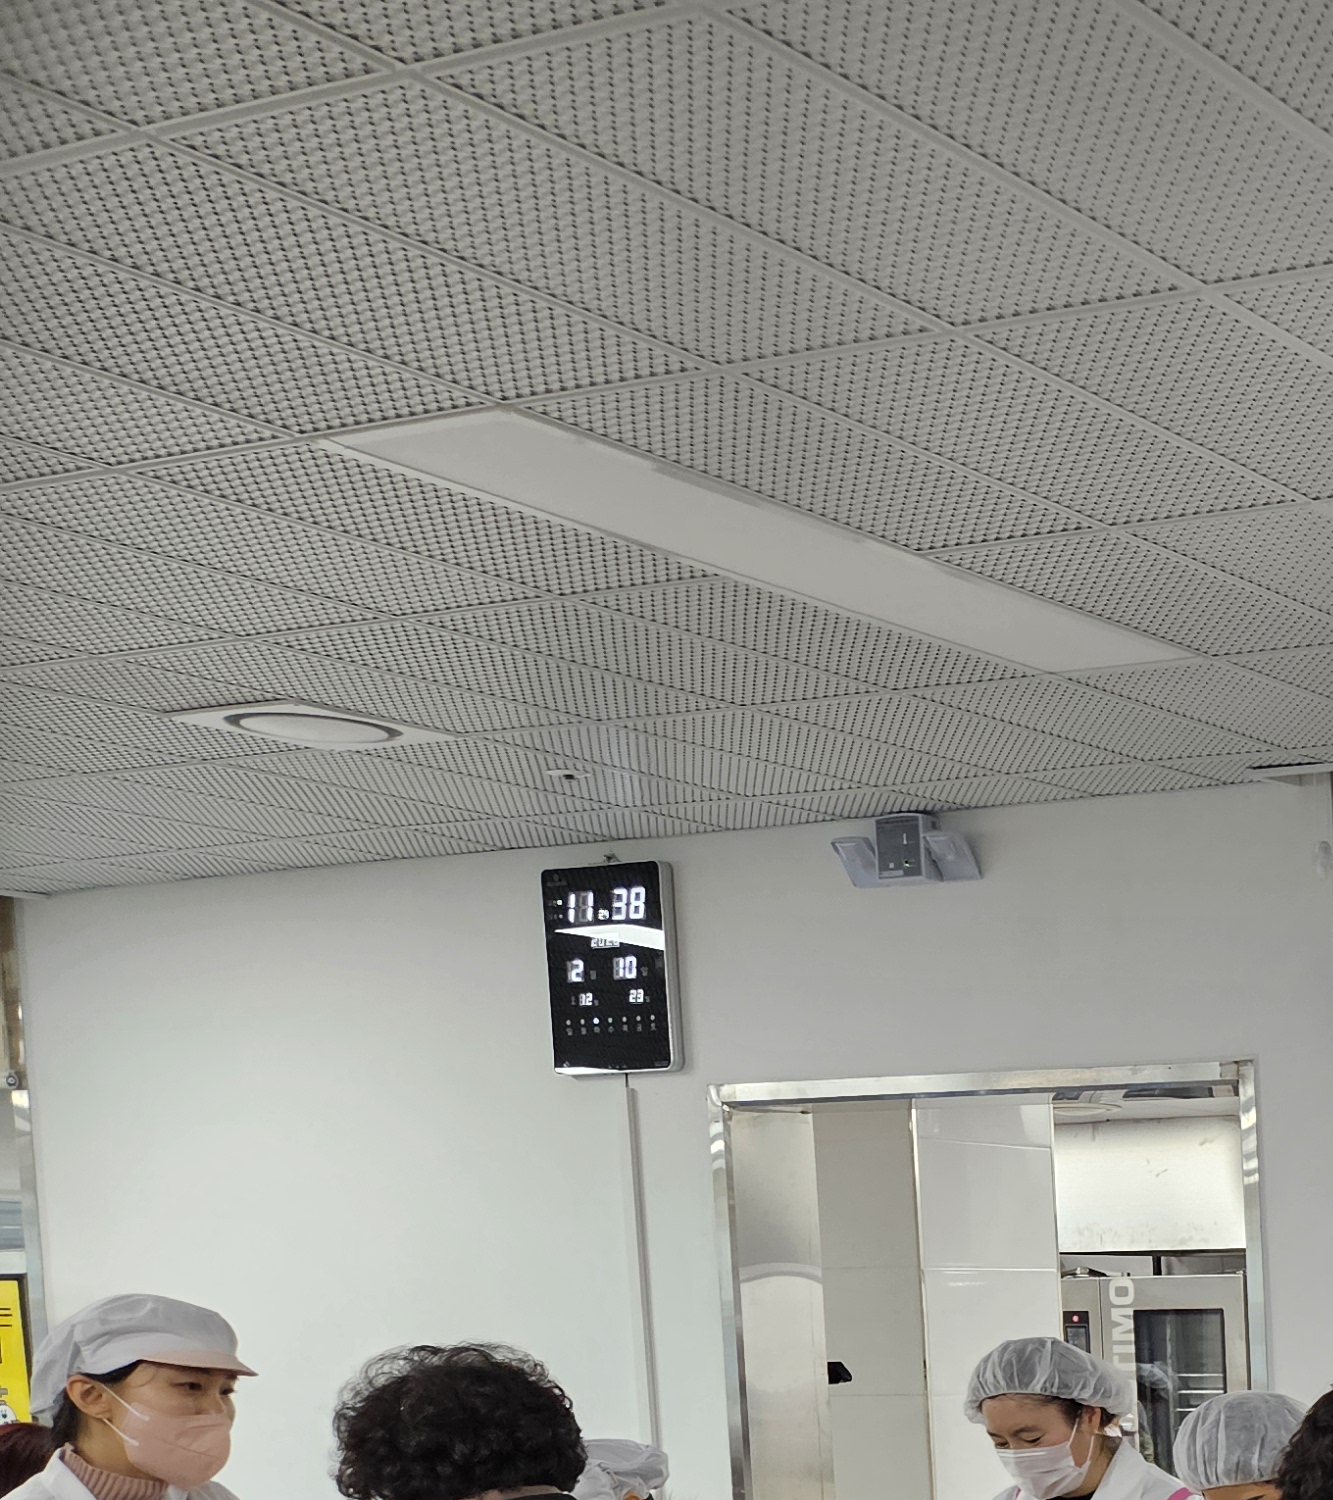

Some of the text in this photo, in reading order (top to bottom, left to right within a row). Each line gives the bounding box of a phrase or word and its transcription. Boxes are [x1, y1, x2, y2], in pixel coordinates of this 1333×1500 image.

[566, 891, 594, 923] 11
[612, 886, 646, 920] 38
[569, 958, 584, 982] 2
[617, 955, 637, 979] 10
